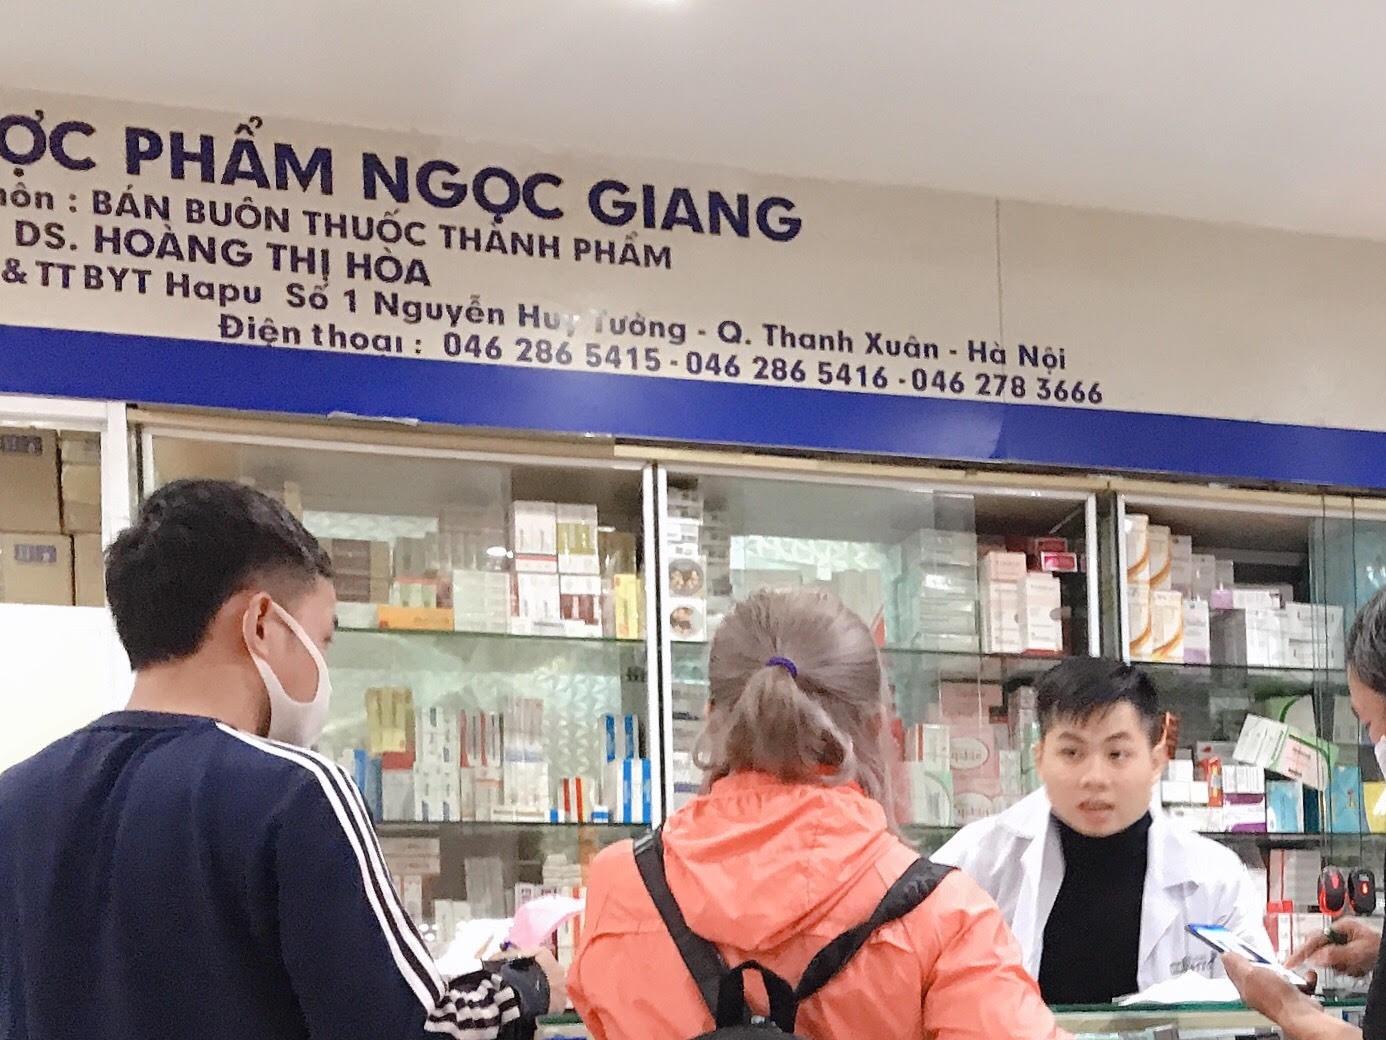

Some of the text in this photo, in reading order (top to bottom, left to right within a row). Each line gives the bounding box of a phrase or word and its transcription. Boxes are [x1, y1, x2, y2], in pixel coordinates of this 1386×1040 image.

[125, 116, 334, 196] PHẨM
[363, 154, 565, 224] NGỌC
[587, 179, 802, 242] GIANG
[15, 220, 431, 287] DS. HOÀNG THỊ HÒA
[92, 184, 171, 220] BÁN
[186, 196, 290, 233] BUÔN
[302, 207, 427, 247] THUỐC
[439, 223, 561, 260] THÀNH
[573, 231, 672, 270] PHẨM
[2, 259, 28, 285] &
[166, 272, 262, 307] Hapu
[285, 280, 329, 311] Số
[343, 288, 356, 313] 1
[374, 294, 505, 329] Nguyễn
[717, 319, 751, 346] Q.
[763, 323, 855, 353] Thanh
[864, 330, 939, 360] Xuân
[967, 338, 1007, 365] Hà
[1018, 344, 1067, 376] Nội
[218, 313, 301, 347] Điện
[443, 332, 503, 361] 046
[514, 338, 574, 366] 286
[586, 342, 662, 373] 5415
[686, 351, 740, 379] 046
[752, 356, 806, 382] 286
[817, 360, 888, 389] 5416
[911, 367, 966, 394] 046
[974, 371, 1027, 399] 278
[1036, 376, 1104, 405] 3666
